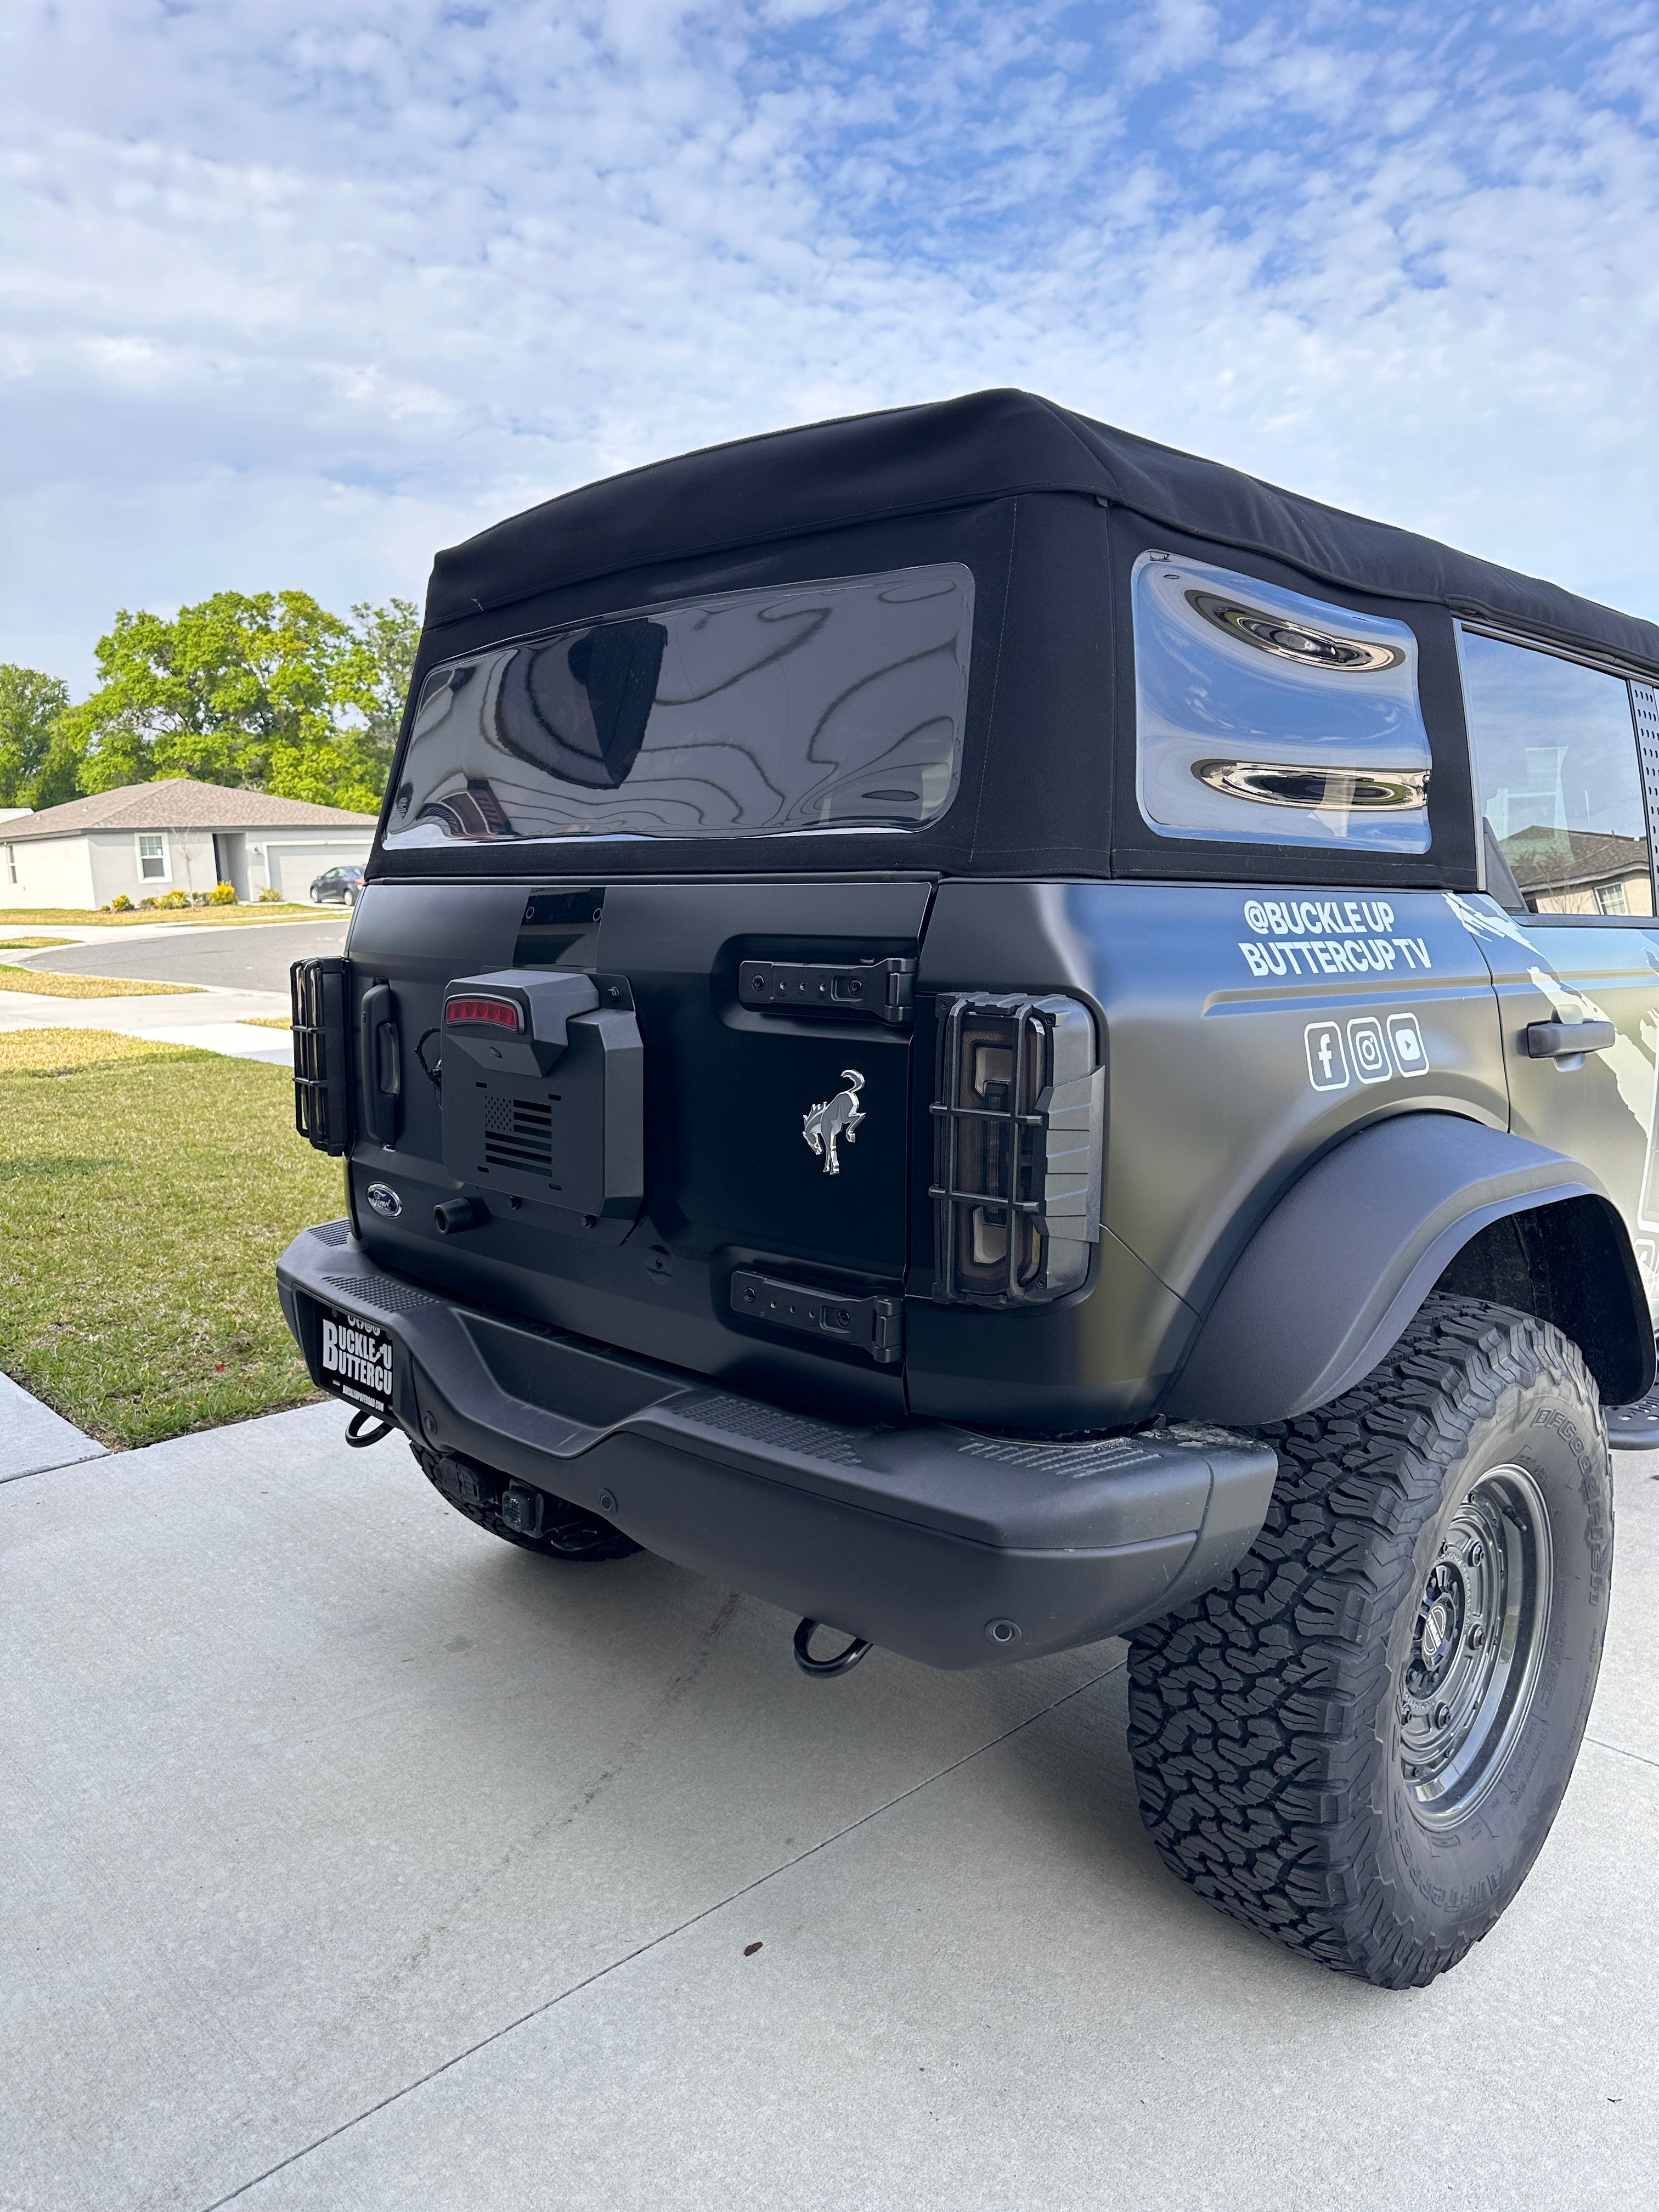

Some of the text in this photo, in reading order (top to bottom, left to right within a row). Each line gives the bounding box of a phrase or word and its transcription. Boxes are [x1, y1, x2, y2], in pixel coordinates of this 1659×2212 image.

[1243, 900, 1395, 934] @BUCKLE UP
[1238, 938, 1432, 977] BUTTERCUP TV
[373, 1190, 391, 1211] Ford
[323, 1319, 376, 1365] BUCKLE
